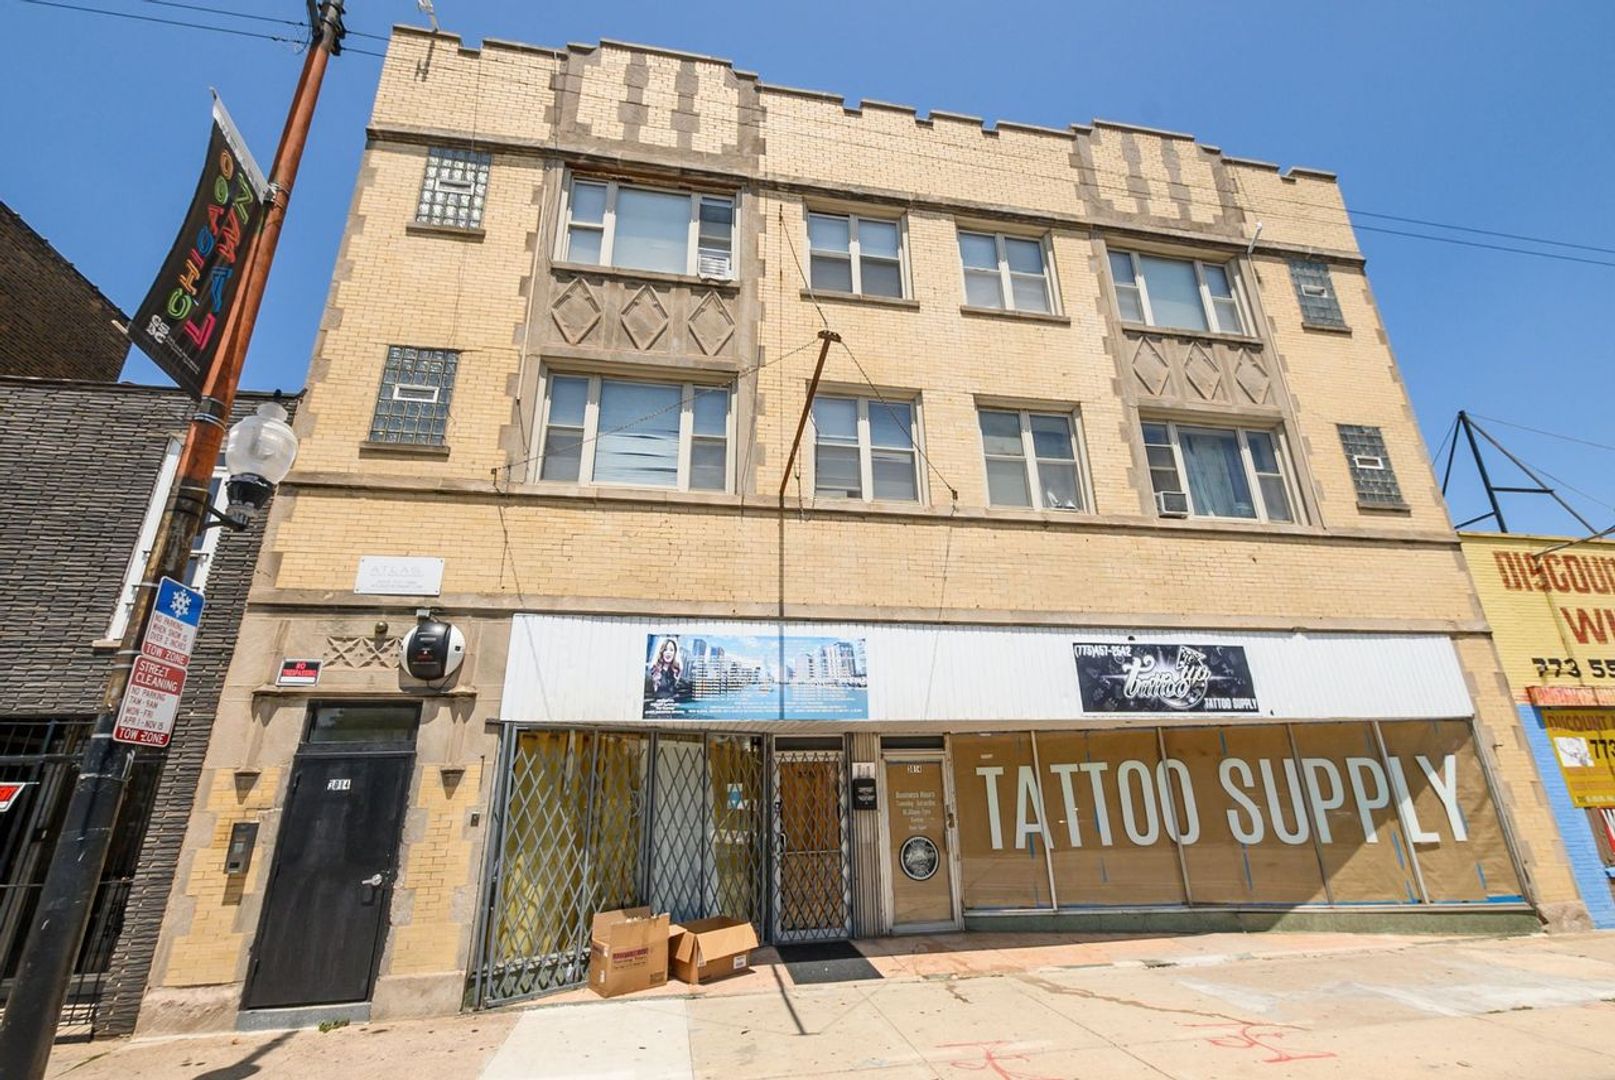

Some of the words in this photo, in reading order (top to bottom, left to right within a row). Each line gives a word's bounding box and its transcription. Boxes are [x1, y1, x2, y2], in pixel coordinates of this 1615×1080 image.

[167, 150, 234, 320] CHICAGO
[184, 172, 254, 350] LAWN
[145, 644, 163, 657] TOW
[165, 651, 187, 665] ZONE
[139, 661, 170, 678] STREET
[1532, 658, 1581, 679] 773
[135, 672, 178, 692] CLEANING
[142, 688, 166, 701] PARKING
[1546, 715, 1609, 732] DISCOUNT
[119, 728, 138, 740] TOW
[140, 731, 166, 744] ZONE
[976, 758, 1200, 850] TATTOO
[1219, 755, 1469, 846] SUPPLY
